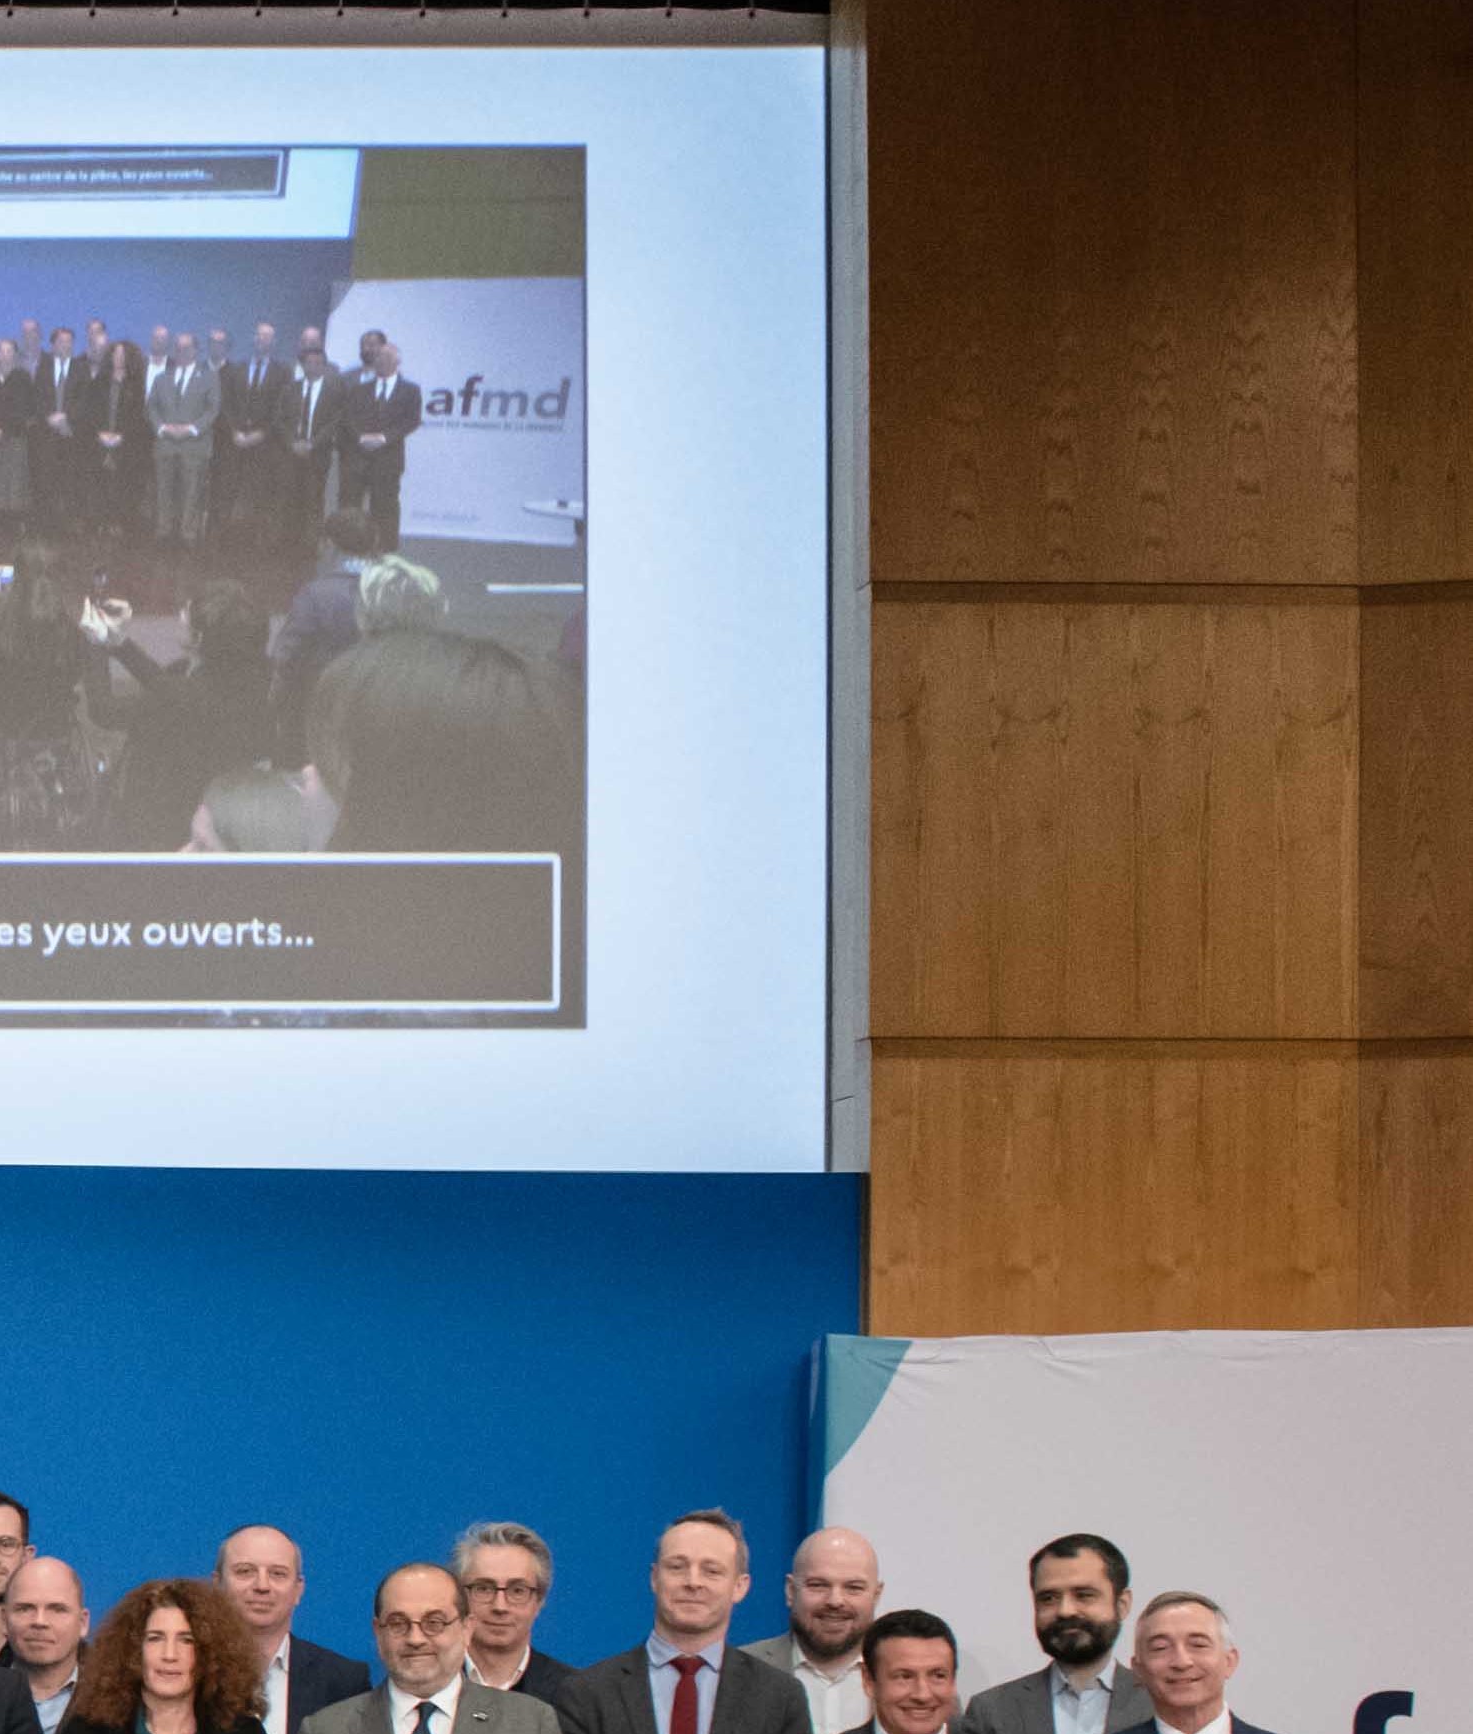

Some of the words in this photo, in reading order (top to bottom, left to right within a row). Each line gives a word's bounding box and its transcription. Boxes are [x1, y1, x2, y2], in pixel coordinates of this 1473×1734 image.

[425, 374, 572, 420] afmd
[42, 923, 130, 956] yeux
[142, 917, 316, 948] ouverts...
